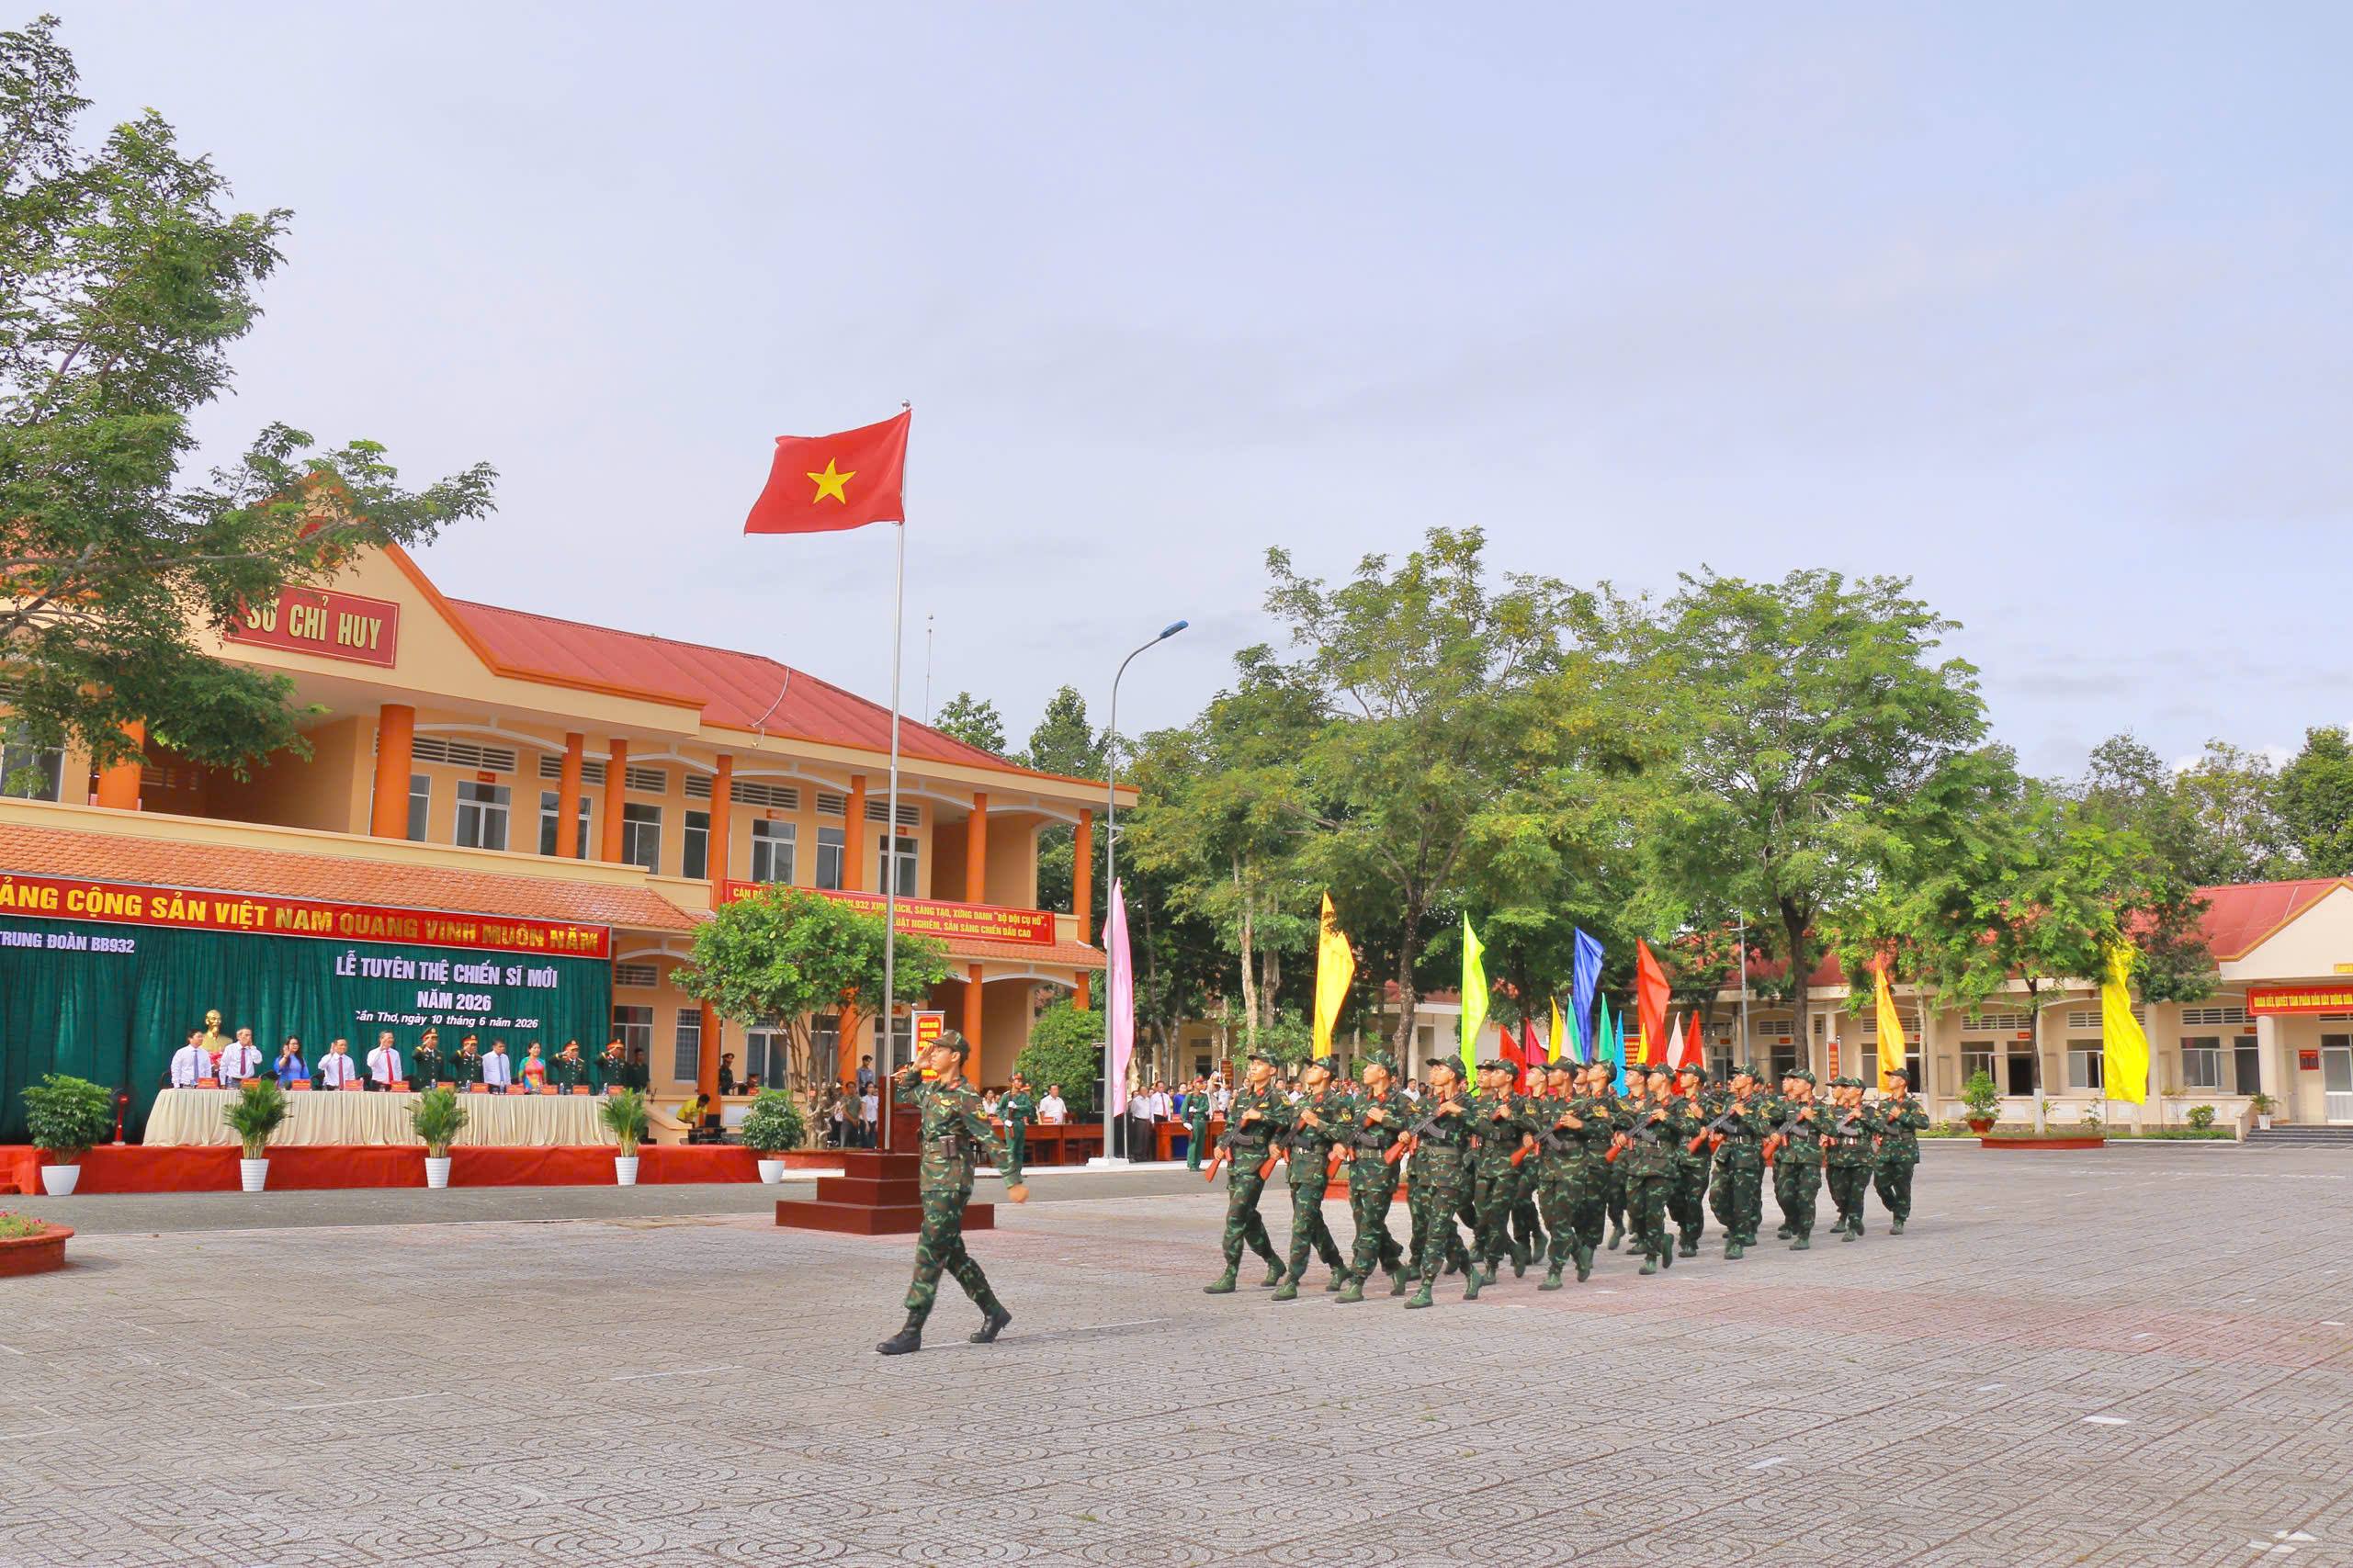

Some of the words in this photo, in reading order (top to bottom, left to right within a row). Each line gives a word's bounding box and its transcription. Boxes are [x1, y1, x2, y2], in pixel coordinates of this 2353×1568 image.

[288, 595, 328, 641] CHỈ
[337, 612, 382, 650] HUY
[0, 875, 59, 910] ẢNG
[66, 886, 142, 918] CỘNG
[150, 891, 207, 922] SẢN
[214, 899, 268, 930] VIỆT
[275, 907, 333, 932] NAM
[339, 912, 418, 939] QUANG
[424, 919, 476, 942] VINH
[481, 922, 545, 947] MUÔN
[549, 927, 598, 951] NĂM
[47, 931, 87, 951] ĐOÀN
[91, 936, 135, 953] BB932
[335, 950, 356, 976] LỄ
[361, 956, 414, 980] TUYÊN
[418, 959, 449, 986] THỆ
[453, 959, 501, 986] CHIẾN
[505, 964, 522, 987] SĨ
[527, 965, 558, 988] MỚI
[416, 987, 453, 1010] NĂM
[456, 993, 492, 1011] 2026
[401, 1013, 427, 1026] ngày
[432, 1014, 443, 1024] 10
[446, 1014, 476, 1028] tháng
[479, 1016, 486, 1026] 6
[489, 1016, 512, 1027] năm
[515, 1018, 539, 1029] 2026
